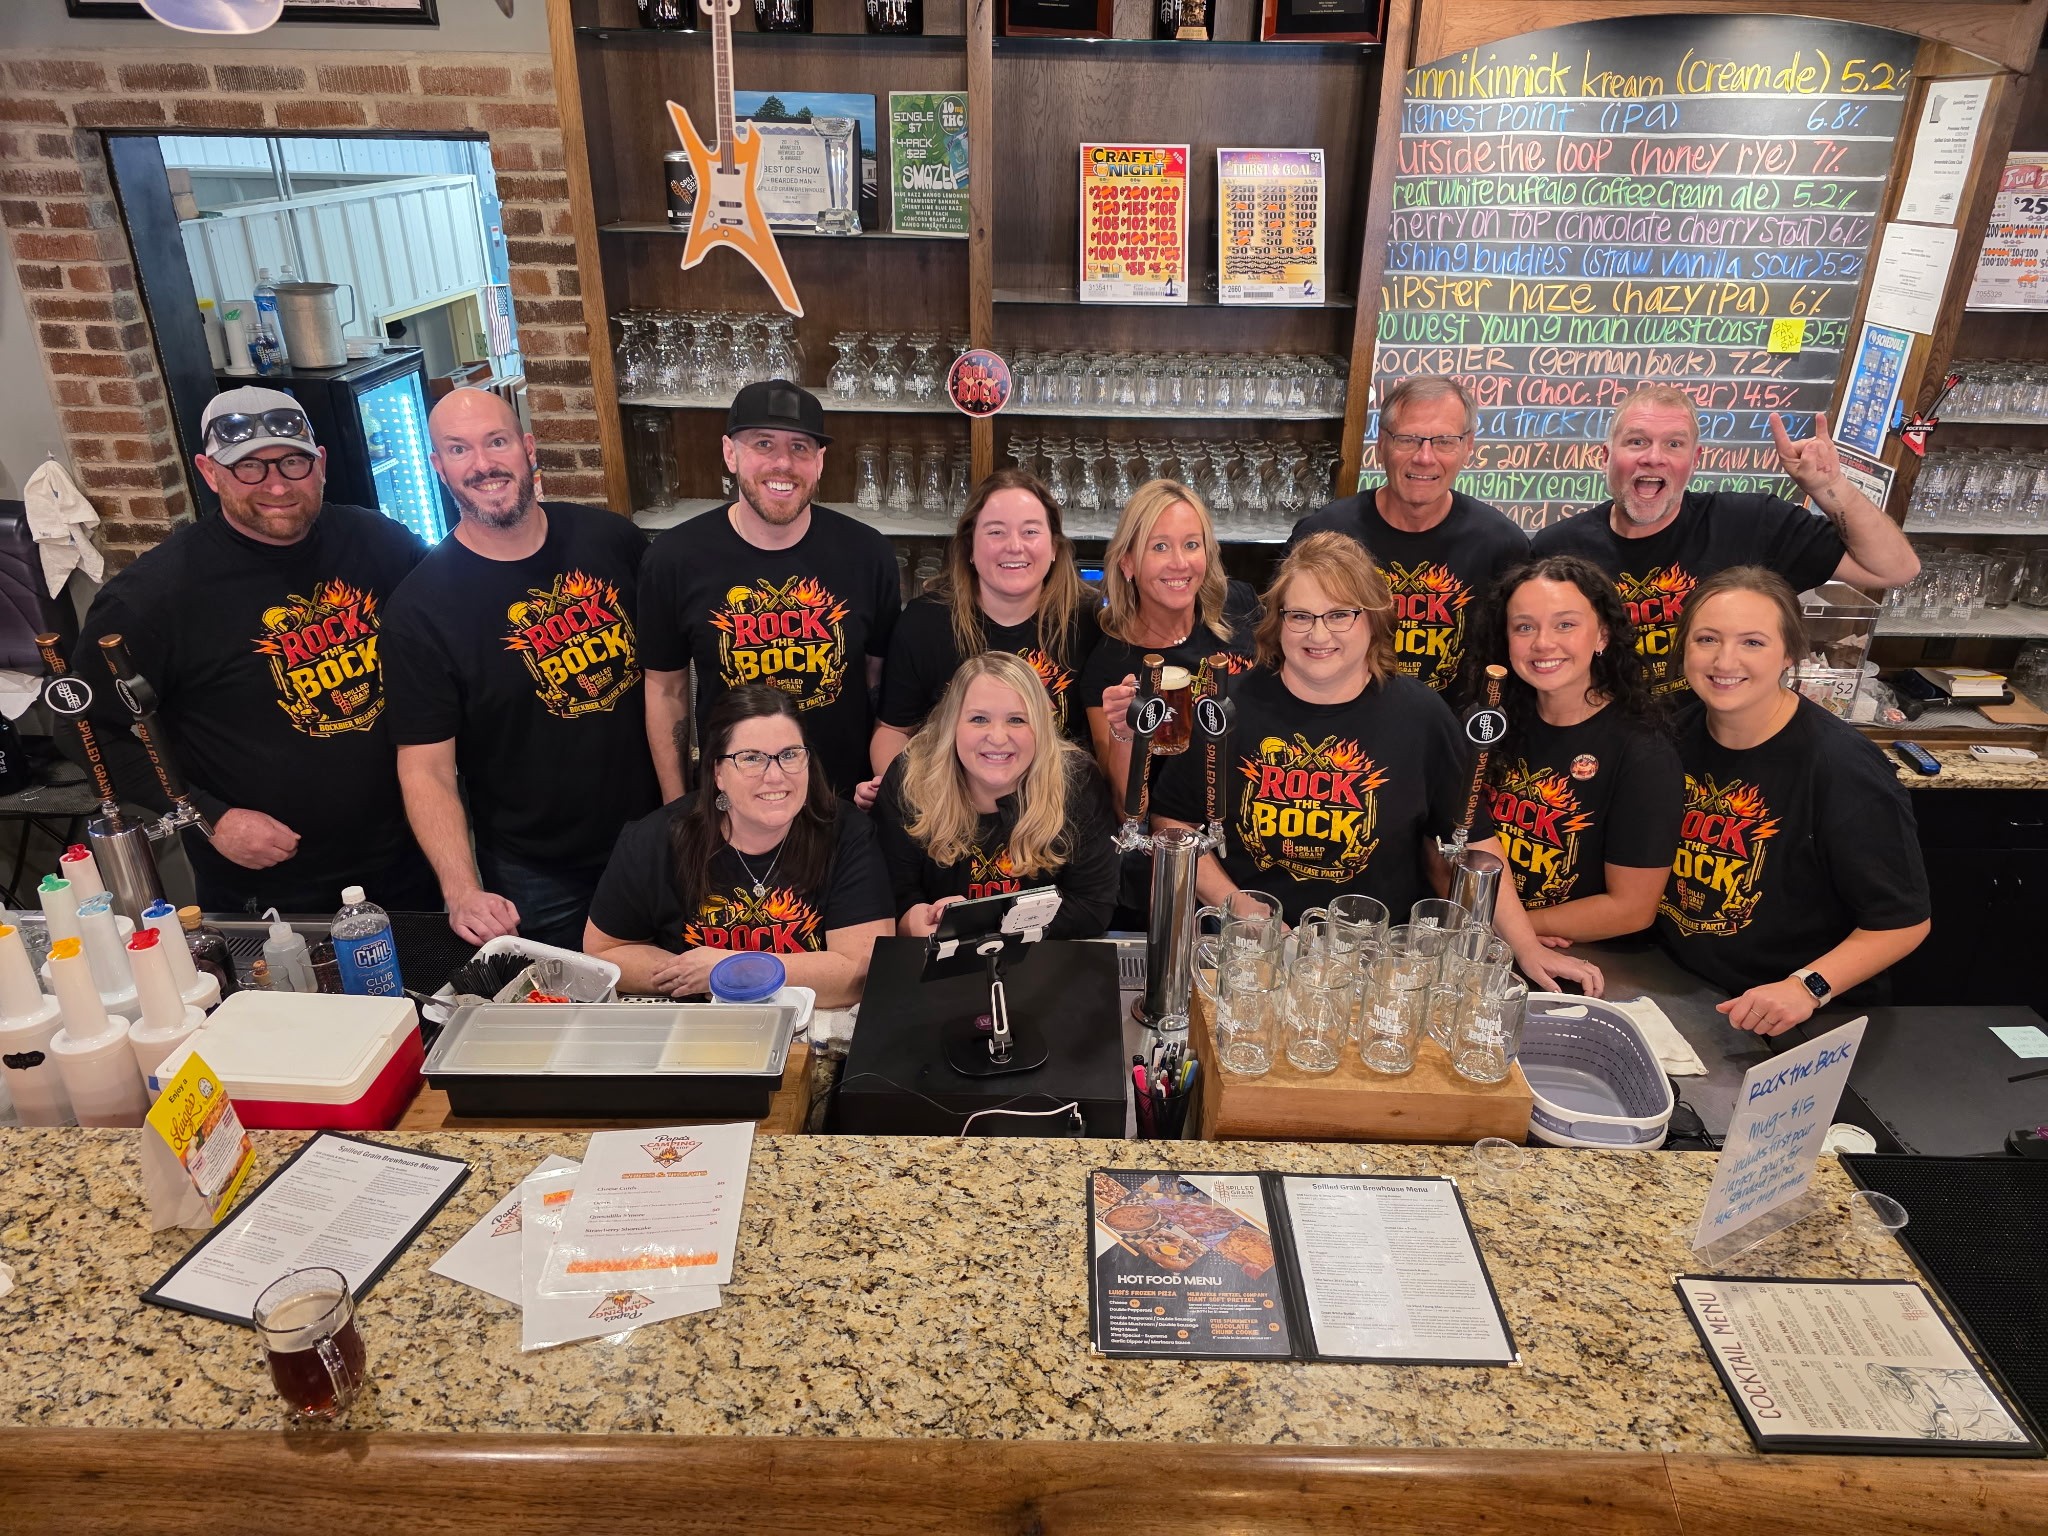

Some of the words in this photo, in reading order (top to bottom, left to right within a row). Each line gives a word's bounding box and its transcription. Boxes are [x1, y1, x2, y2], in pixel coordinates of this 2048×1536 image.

[1582, 50, 1664, 97] kream
[1840, 59, 1911, 92] 5.2%
[942, 102, 954, 113] 10
[1807, 100, 1868, 132] 6.8%
[894, 112, 933, 122] SINGLE
[942, 115, 963, 127] THC
[909, 123, 922, 133] $7
[897, 139, 932, 148] 4-PACK
[907, 149, 927, 159] $22
[1092, 148, 1153, 163] CRAFT
[1311, 154, 1321, 163] $2
[1498, 136, 1546, 174] the
[1631, 138, 1730, 177] (honey
[1736, 140, 1798, 176] rye)
[1812, 140, 1848, 173] 7%
[763, 165, 783, 173] BEST
[796, 166, 820, 175] SHOW
[1109, 164, 1166, 177] NIGHT
[1231, 163, 1271, 177] THIRST
[1272, 165, 1281, 174] &
[1283, 163, 1314, 176] GOAL
[1497, 176, 1577, 206] buffalo
[1582, 175, 1656, 209] (coffee
[1730, 180, 1781, 211] ale)
[1793, 182, 1857, 210] 5.2%
[1122, 202, 1148, 216] $155
[1150, 202, 1177, 216] $105
[1092, 216, 1119, 230] $105
[1121, 217, 1148, 230] $102
[1149, 217, 1177, 231] $102
[1471, 209, 1500, 239] on
[1555, 210, 1672, 243] (chocolate
[1678, 210, 1759, 245] cherry
[1091, 231, 1119, 245] $100
[1088, 246, 1117, 261] $100
[1472, 243, 1573, 274] buddies
[1661, 249, 1742, 279] vanilla
[1751, 248, 1822, 280] sour)
[1125, 262, 1145, 275] $55
[1165, 278, 1178, 296] 1
[1304, 279, 1316, 296] 2
[1508, 278, 1597, 314] haze
[1612, 280, 1704, 316] (hazy
[1789, 284, 1831, 316] 6%
[1569, 316, 1632, 345] man
[1634, 316, 1706, 345] (west
[1876, 334, 1905, 352] SCHEDULE
[1529, 348, 1642, 377] (german
[1645, 350, 1717, 377] bock)
[1729, 352, 1792, 379] 7.2%
[957, 380, 1001, 404] ROCK
[1743, 381, 1799, 409] 4.5%
[1491, 411, 1507, 437] a
[1512, 408, 1584, 438] truck
[1496, 441, 1550, 470] 2017:
[1455, 472, 1536, 500] mighty
[522, 592, 619, 660] ROCK
[731, 607, 833, 649] ROCK
[277, 602, 377, 669] ROCK
[565, 632, 589, 647] THE
[771, 638, 795, 648] THE
[321, 645, 346, 660] THE
[538, 623, 627, 686] BOCK
[731, 642, 834, 680] BOCK
[287, 635, 379, 700] BOCK
[589, 666, 612, 683] SPILLED
[342, 682, 370, 699] SPILLED
[349, 689, 370, 702] GRAIN
[600, 688, 620, 706] RELEASE
[619, 674, 634, 691] PARTY
[1834, 681, 1854, 695] $2
[806, 695, 826, 707] PARTY
[354, 708, 379, 726] RELEASE
[136, 722, 160, 768] SPILLED
[77, 719, 101, 763] SPILLED
[93, 762, 114, 799] GRAIN
[1206, 743, 1216, 785] SPILLED
[1472, 752, 1489, 793] SPILLED
[1255, 765, 1363, 810] ROCK
[1206, 785, 1216, 818] GRAIN
[1294, 800, 1320, 809] THE
[1462, 793, 1479, 830] GRAIN
[1252, 801, 1365, 843] BOCK
[1501, 822, 1525, 838] THE
[1684, 840, 1709, 853] THE
[1292, 862, 1319, 877] RELEASE
[1320, 869, 1344, 878] PARTY
[1700, 921, 1727, 931] PARTY
[701, 920, 808, 953] ROCK
[366, 971, 394, 987] CLUB
[367, 982, 396, 997] SODA
[1789, 1058, 1814, 1086] the
[168, 1084, 185, 1104] Enjoy
[1791, 1095, 1815, 1118] $15
[646, 1140, 697, 1149] CAMPING
[655, 1134, 690, 1143] Papa's
[338, 1144, 363, 1158] Spilled
[362, 1149, 383, 1163] Grain
[381, 1155, 420, 1170] Brewhouse
[419, 1161, 440, 1173] Menu
[1312, 1183, 1338, 1191] Spilled
[1117, 1274, 1144, 1285] HOT
[1145, 1275, 1182, 1285] FOOD
[1184, 1276, 1223, 1286] MENU
[1694, 1292, 1736, 1336] MENU
[1722, 1341, 1782, 1420] COCKTAIL
